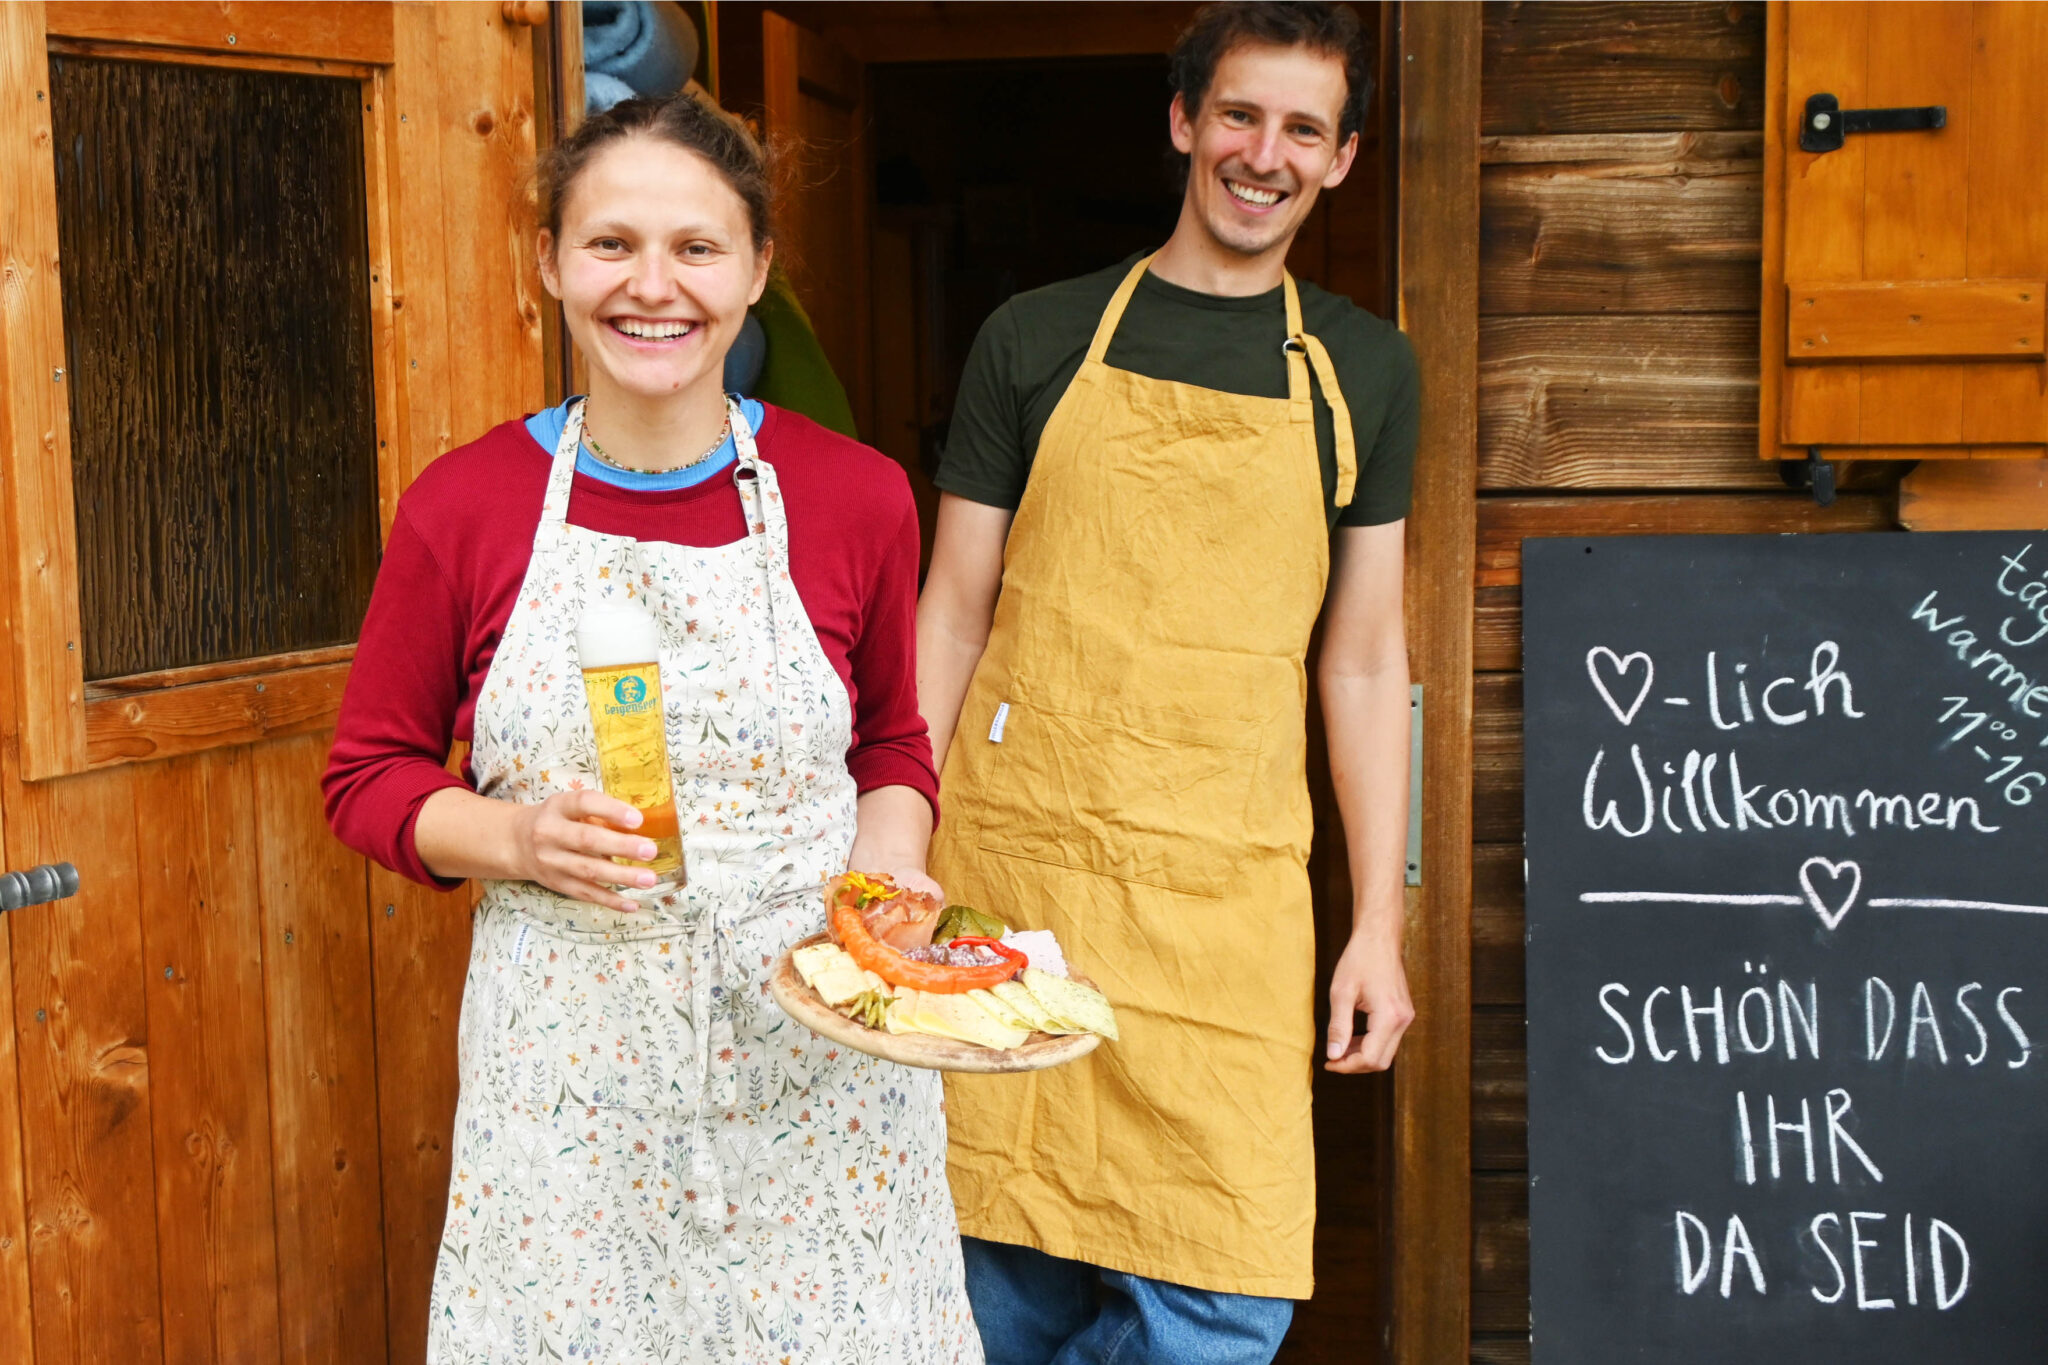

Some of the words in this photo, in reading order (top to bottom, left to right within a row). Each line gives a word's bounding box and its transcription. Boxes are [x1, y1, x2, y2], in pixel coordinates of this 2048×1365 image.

[1583, 744, 2001, 837] Willkommen
[1596, 961, 1819, 1064] SCHÖN
[1866, 976, 2031, 1069] DASS
[1737, 1088, 1883, 1185] IHR
[1676, 1211, 1766, 1298] DA
[1810, 1212, 1970, 1310] SEID
